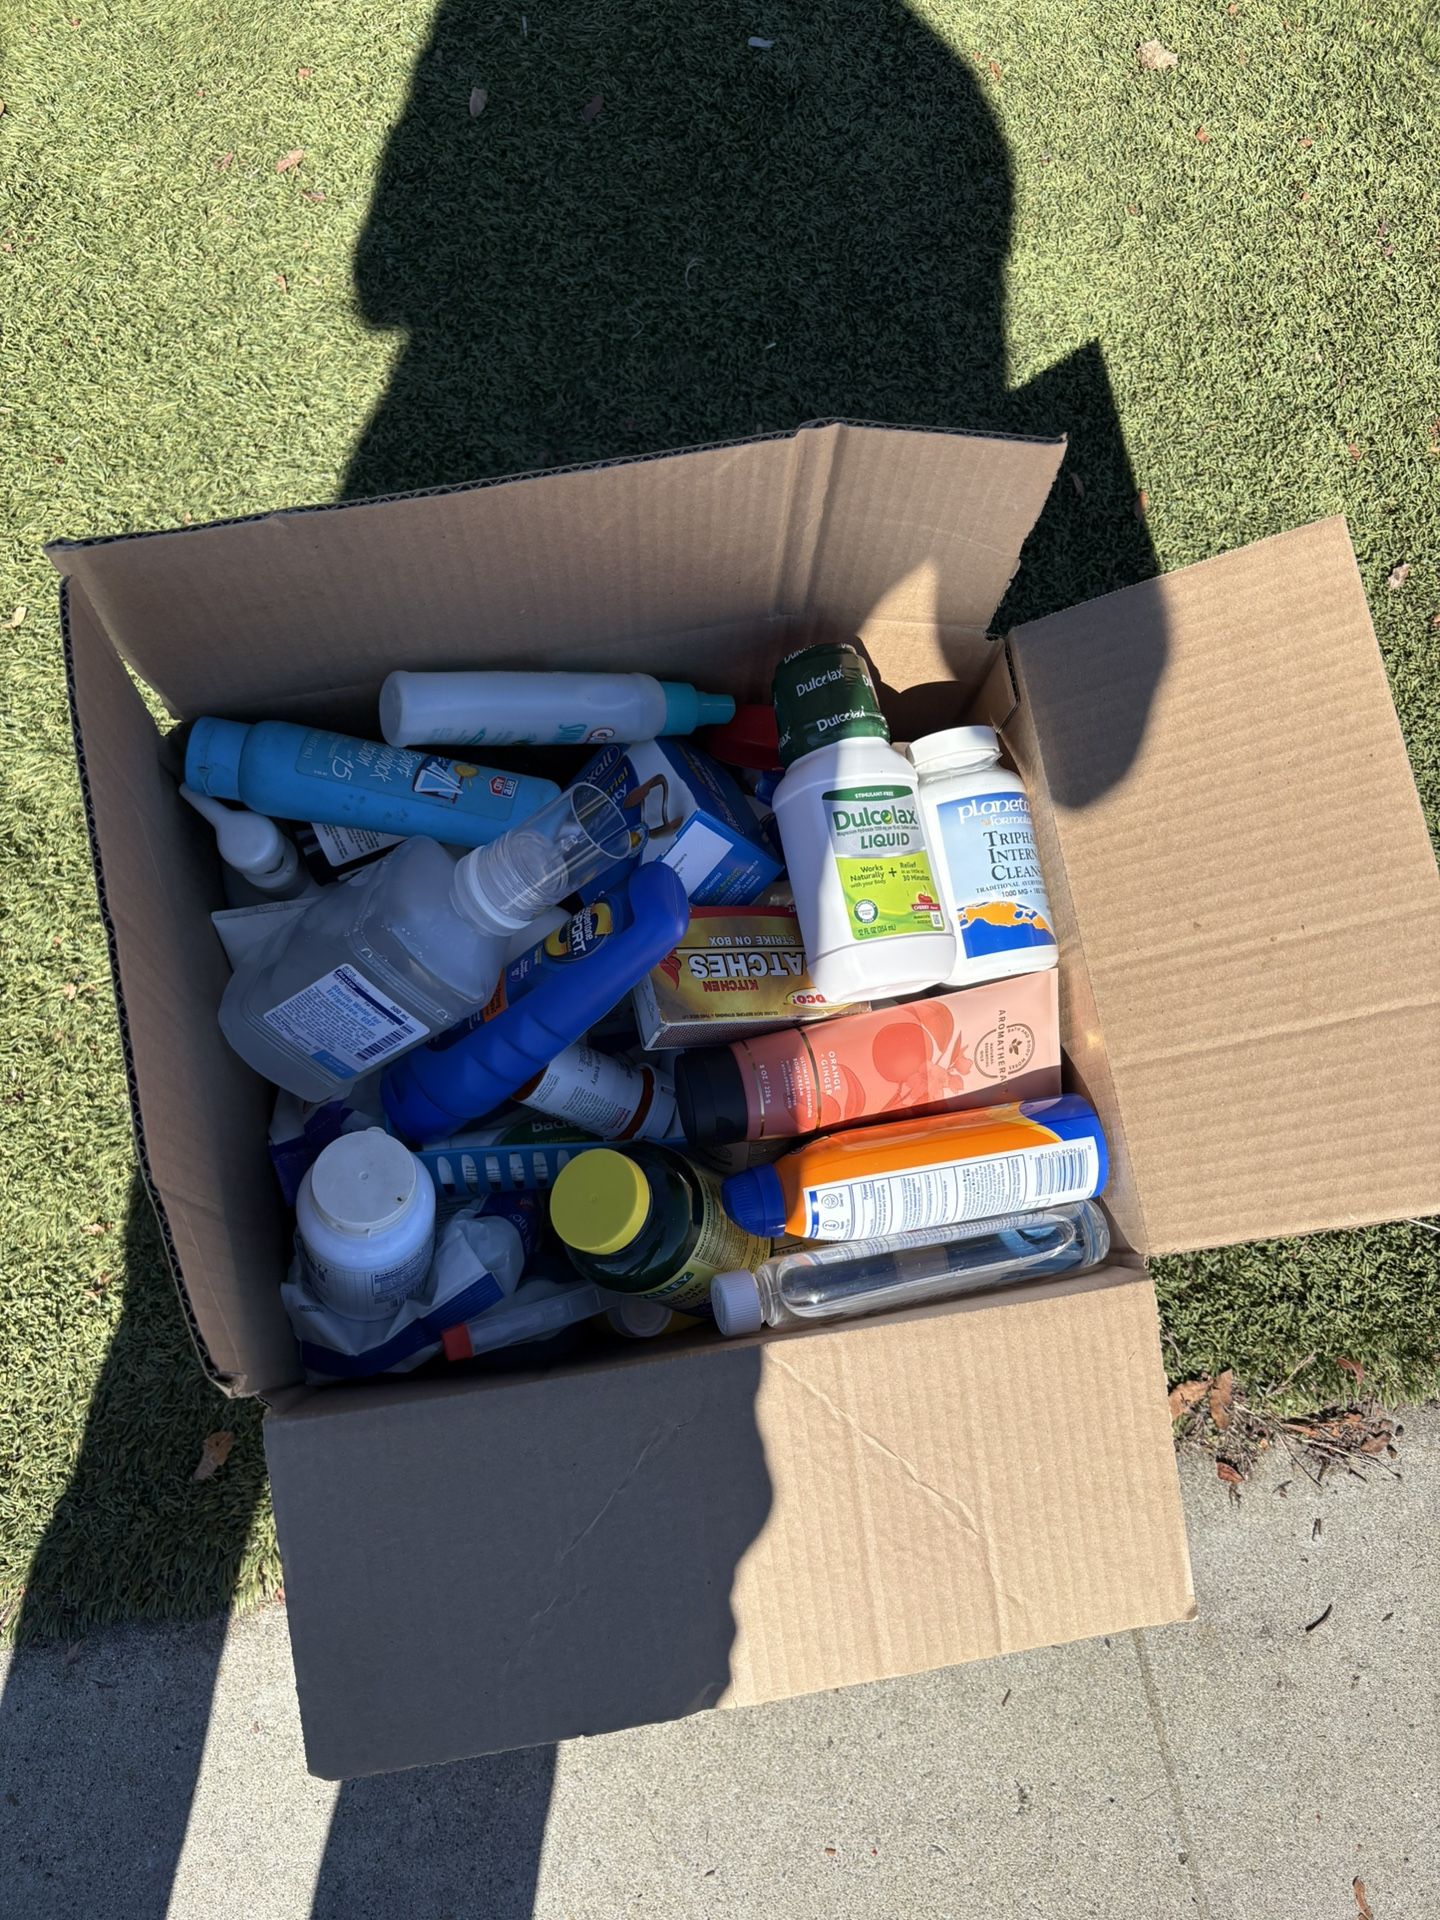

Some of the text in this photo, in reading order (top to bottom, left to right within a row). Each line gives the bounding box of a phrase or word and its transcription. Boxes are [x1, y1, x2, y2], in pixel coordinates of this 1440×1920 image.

[796, 668, 844, 697] Dulcolax
[331, 755, 354, 781] 15
[832, 805, 918, 831] Dulcolax
[860, 832, 910, 850] LIQUID
[850, 871, 885, 882] Naturally
[859, 864, 884, 873] Works
[1001, 890, 1018, 898] 1000
[710, 936, 796, 946] STRIKE ON BOX
[687, 951, 806, 980] ATCHES
[702, 979, 760, 993] KITCHEN
[792, 994, 826, 1005] DCO!
[996, 1009, 1009, 1090] AROMATHERA
[820, 1059, 833, 1096] GINGER
[828, 1050, 841, 1091] ORANGE
